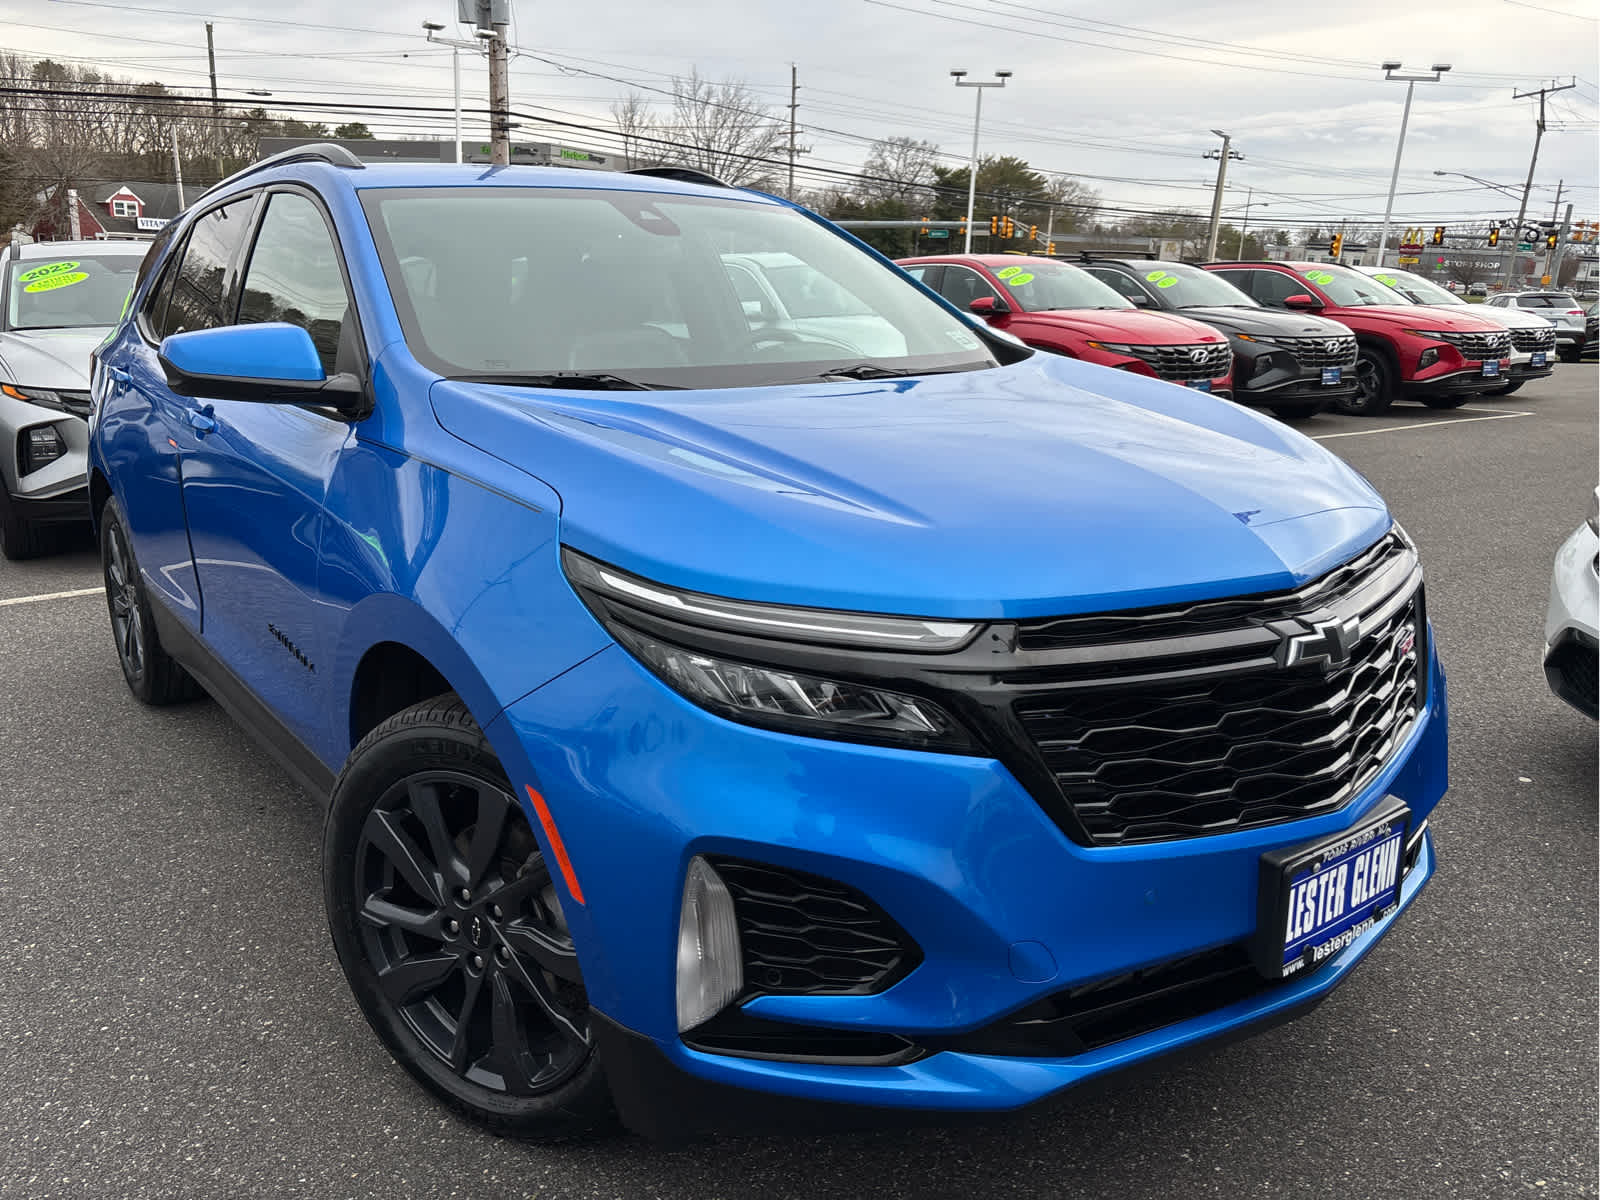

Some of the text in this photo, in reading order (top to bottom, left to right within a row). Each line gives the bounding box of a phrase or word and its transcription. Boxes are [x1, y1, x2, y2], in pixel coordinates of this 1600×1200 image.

[26, 262, 74, 280] 2023
[1285, 836, 1401, 943] LESTER GLENN
